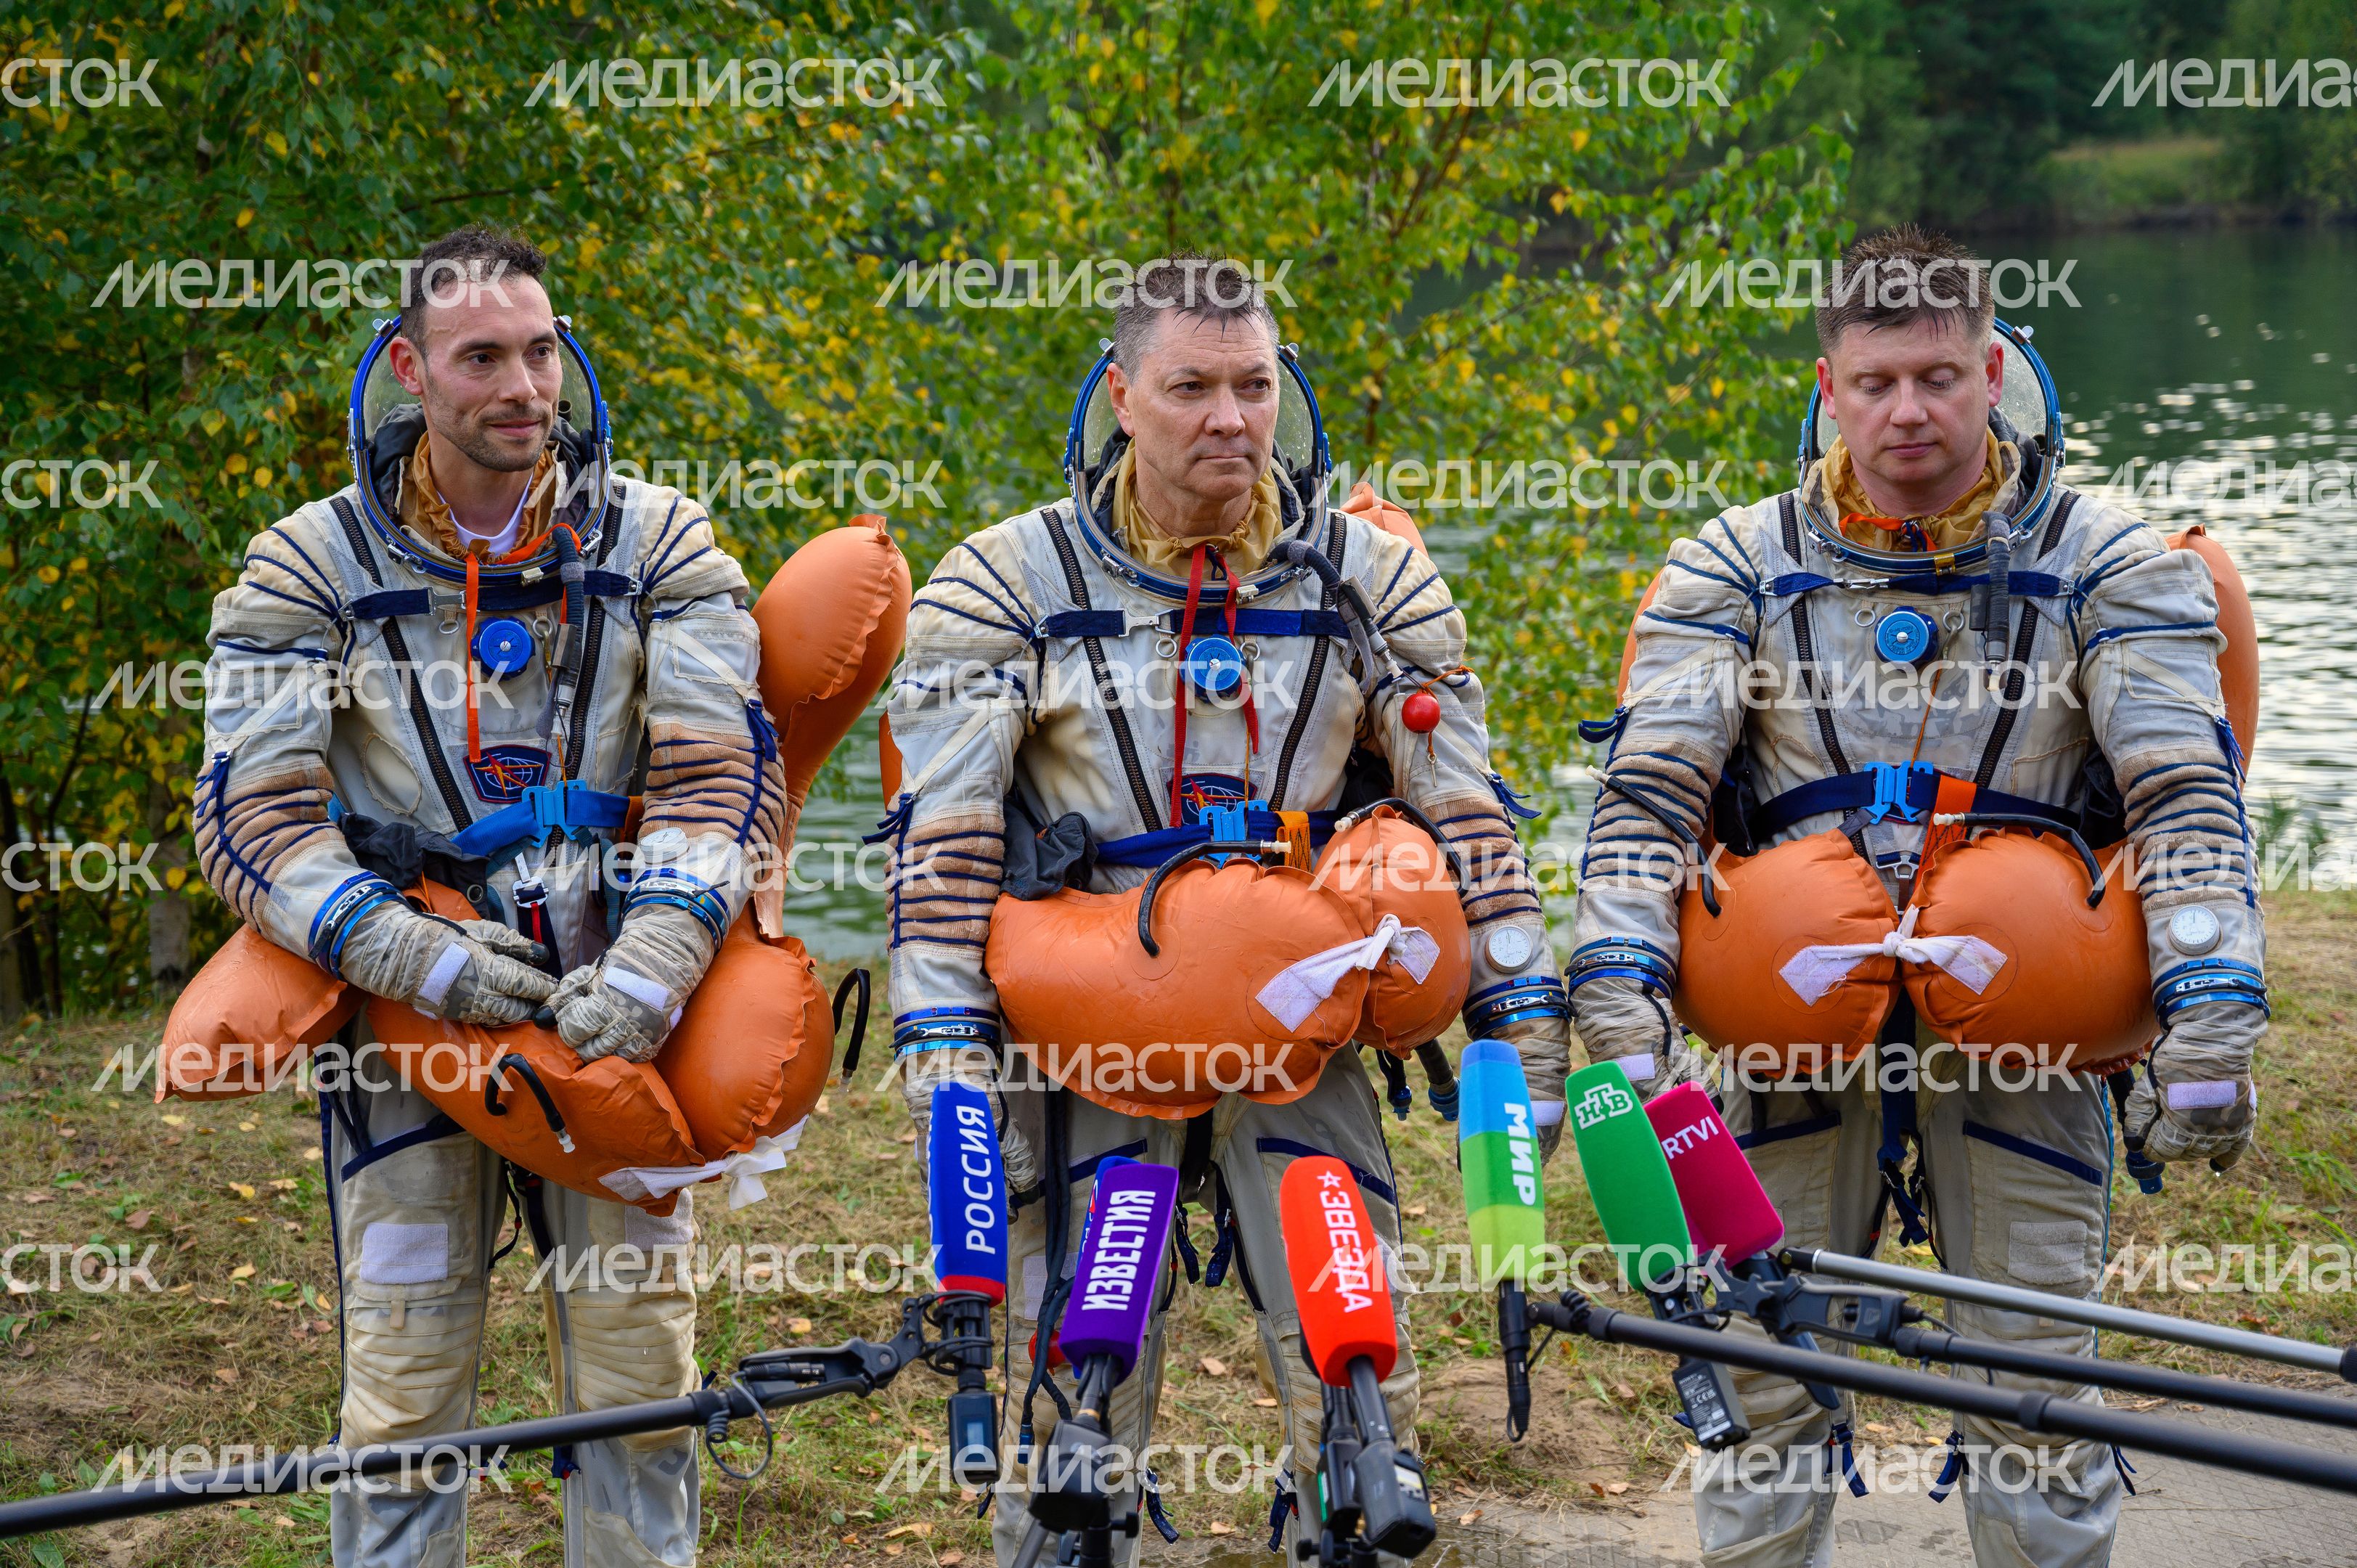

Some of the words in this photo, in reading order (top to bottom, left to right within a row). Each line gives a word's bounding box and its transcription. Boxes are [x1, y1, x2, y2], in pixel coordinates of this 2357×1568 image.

[1504, 1103, 1536, 1206] МИР
[1574, 1082, 1633, 1130] НТВ
[1662, 1116, 1719, 1160] RTVI
[956, 1105, 995, 1254] РОССИЯ
[1082, 1191, 1156, 1310] ИЗВЕСТИЯ
[1320, 1191, 1373, 1312] ЗВЕЗДА
